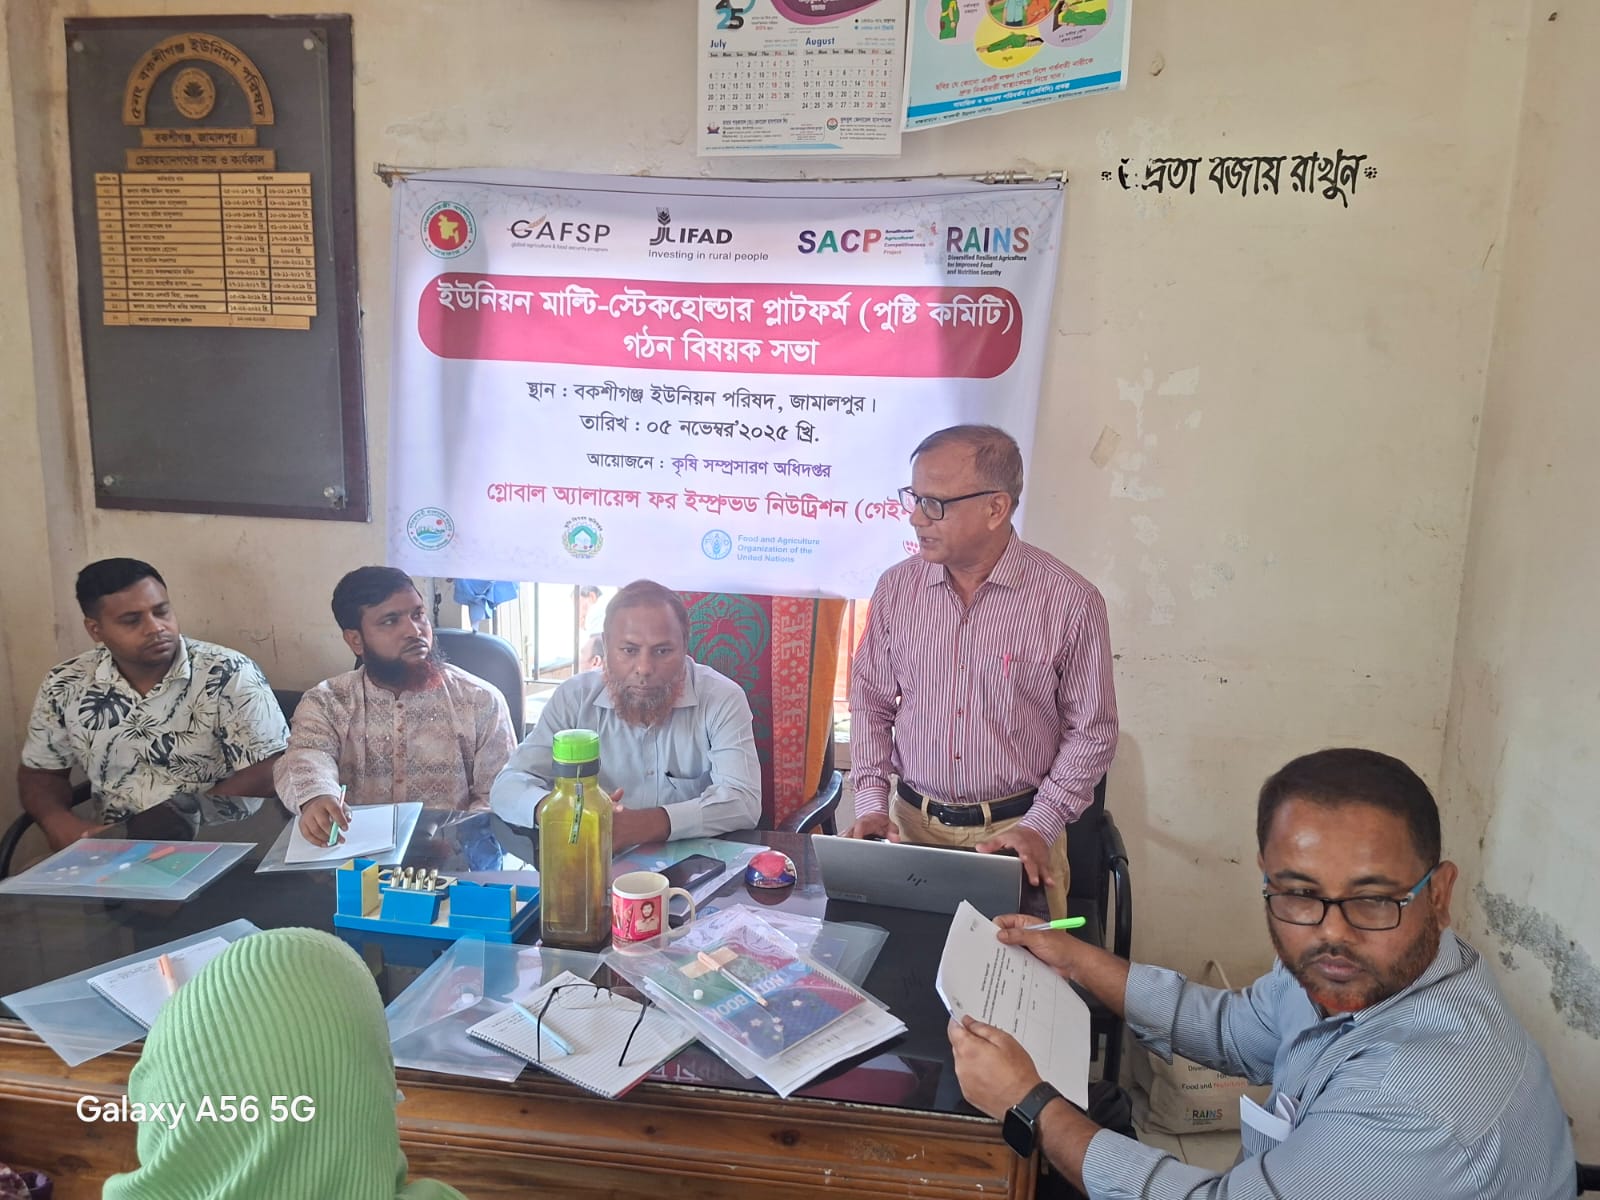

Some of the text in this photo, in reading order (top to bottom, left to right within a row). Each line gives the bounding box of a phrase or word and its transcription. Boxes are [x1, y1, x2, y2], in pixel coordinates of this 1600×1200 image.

[710, 39, 726, 50] July
[806, 37, 834, 47] August
[1209, 156, 1287, 197] বজায়
[1290, 149, 1367, 208] রাখুন
[510, 219, 611, 243] GAFSP
[680, 228, 733, 244] IFAD
[798, 229, 882, 254] SACP
[946, 226, 1030, 253] RAINS
[648, 250, 769, 262] Investing in rural people
[436, 278, 1014, 335] ইউনিয়ন মাল্টি-স্টেকহোল্ডার প্লাটফর্ম (পুষ্টি কমিটি)
[624, 325, 820, 366] গঠন বিষয়ক সভা
[527, 381, 556, 401] স্থান
[573, 380, 643, 404] বকশীগঞ্জ
[651, 383, 716, 408] ইউনিয়ন
[722, 387, 783, 414] পরিষদ,
[790, 393, 865, 415] জামালপুর
[579, 410, 629, 432] তারিখ
[646, 421, 672, 435] ০৫
[587, 453, 654, 469] আয়োজনে
[672, 454, 698, 477] কৃষি
[704, 458, 768, 476] সম্প্রসারণ
[774, 458, 832, 478] অধিদপ্তর
[487, 482, 546, 503] গ্লোবাল
[552, 486, 641, 508] অ্যালায়েন্স
[647, 491, 678, 510] ফর
[766, 492, 848, 520] নিউট্রিশন
[854, 497, 914, 523] (গেই
[738, 534, 820, 546] Food and Agriculture
[738, 544, 788, 553] Organization
[737, 554, 795, 563] United Nations
[1192, 1108, 1223, 1120] RAINS
